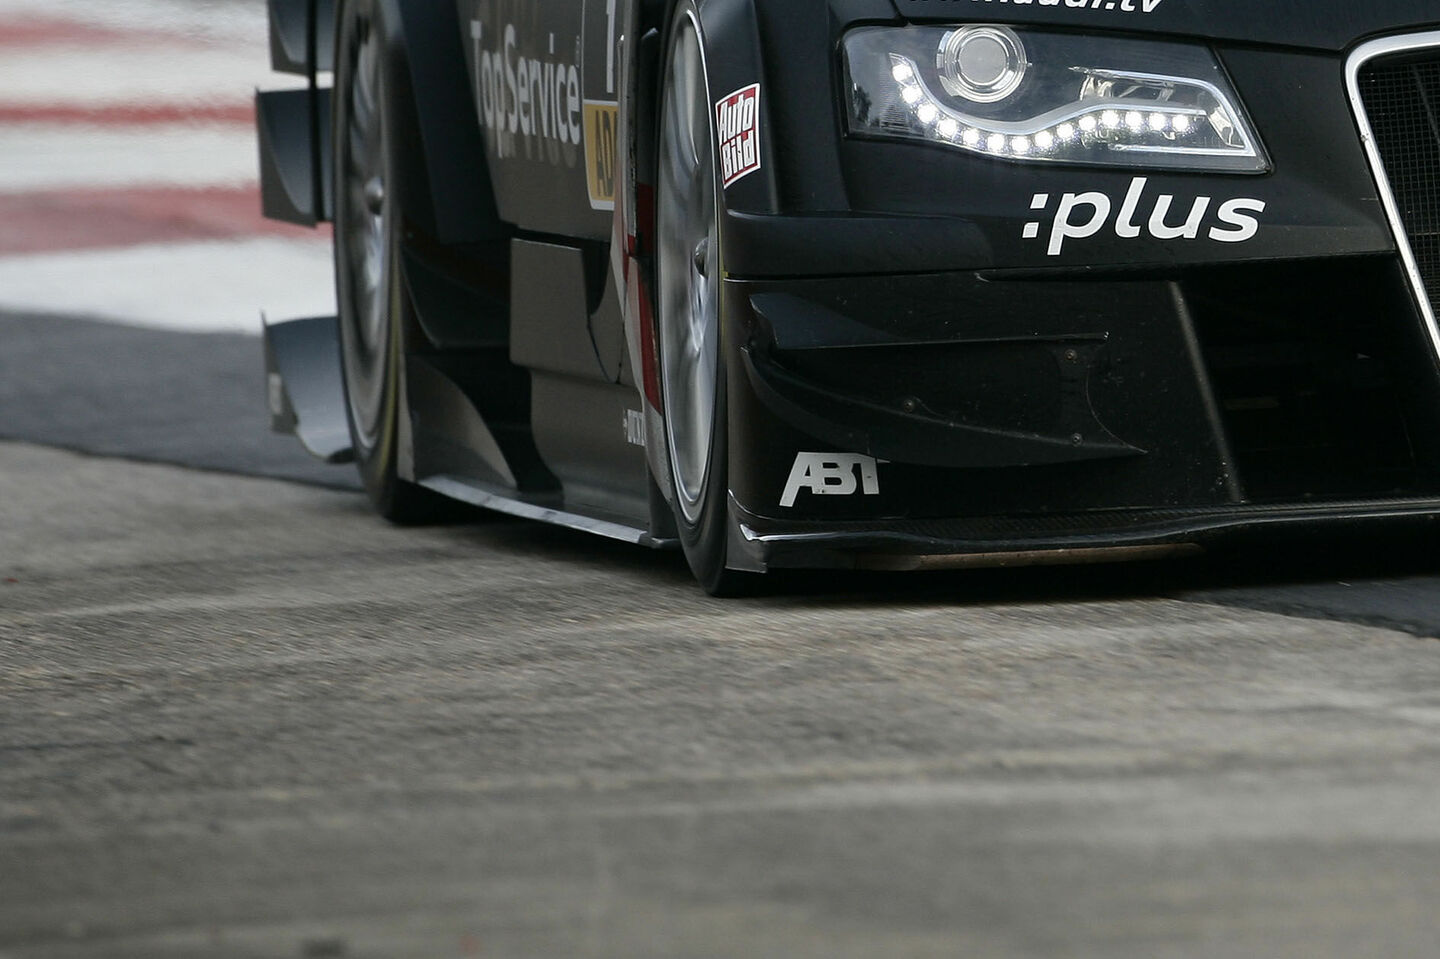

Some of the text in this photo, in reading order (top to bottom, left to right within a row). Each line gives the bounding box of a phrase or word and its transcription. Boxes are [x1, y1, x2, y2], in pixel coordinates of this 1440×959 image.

[470, 19, 581, 160] TopService
[720, 93, 755, 144] Auto
[721, 129, 756, 181] Bild
[1022, 176, 1267, 256] :plus
[779, 451, 890, 508] ABT
